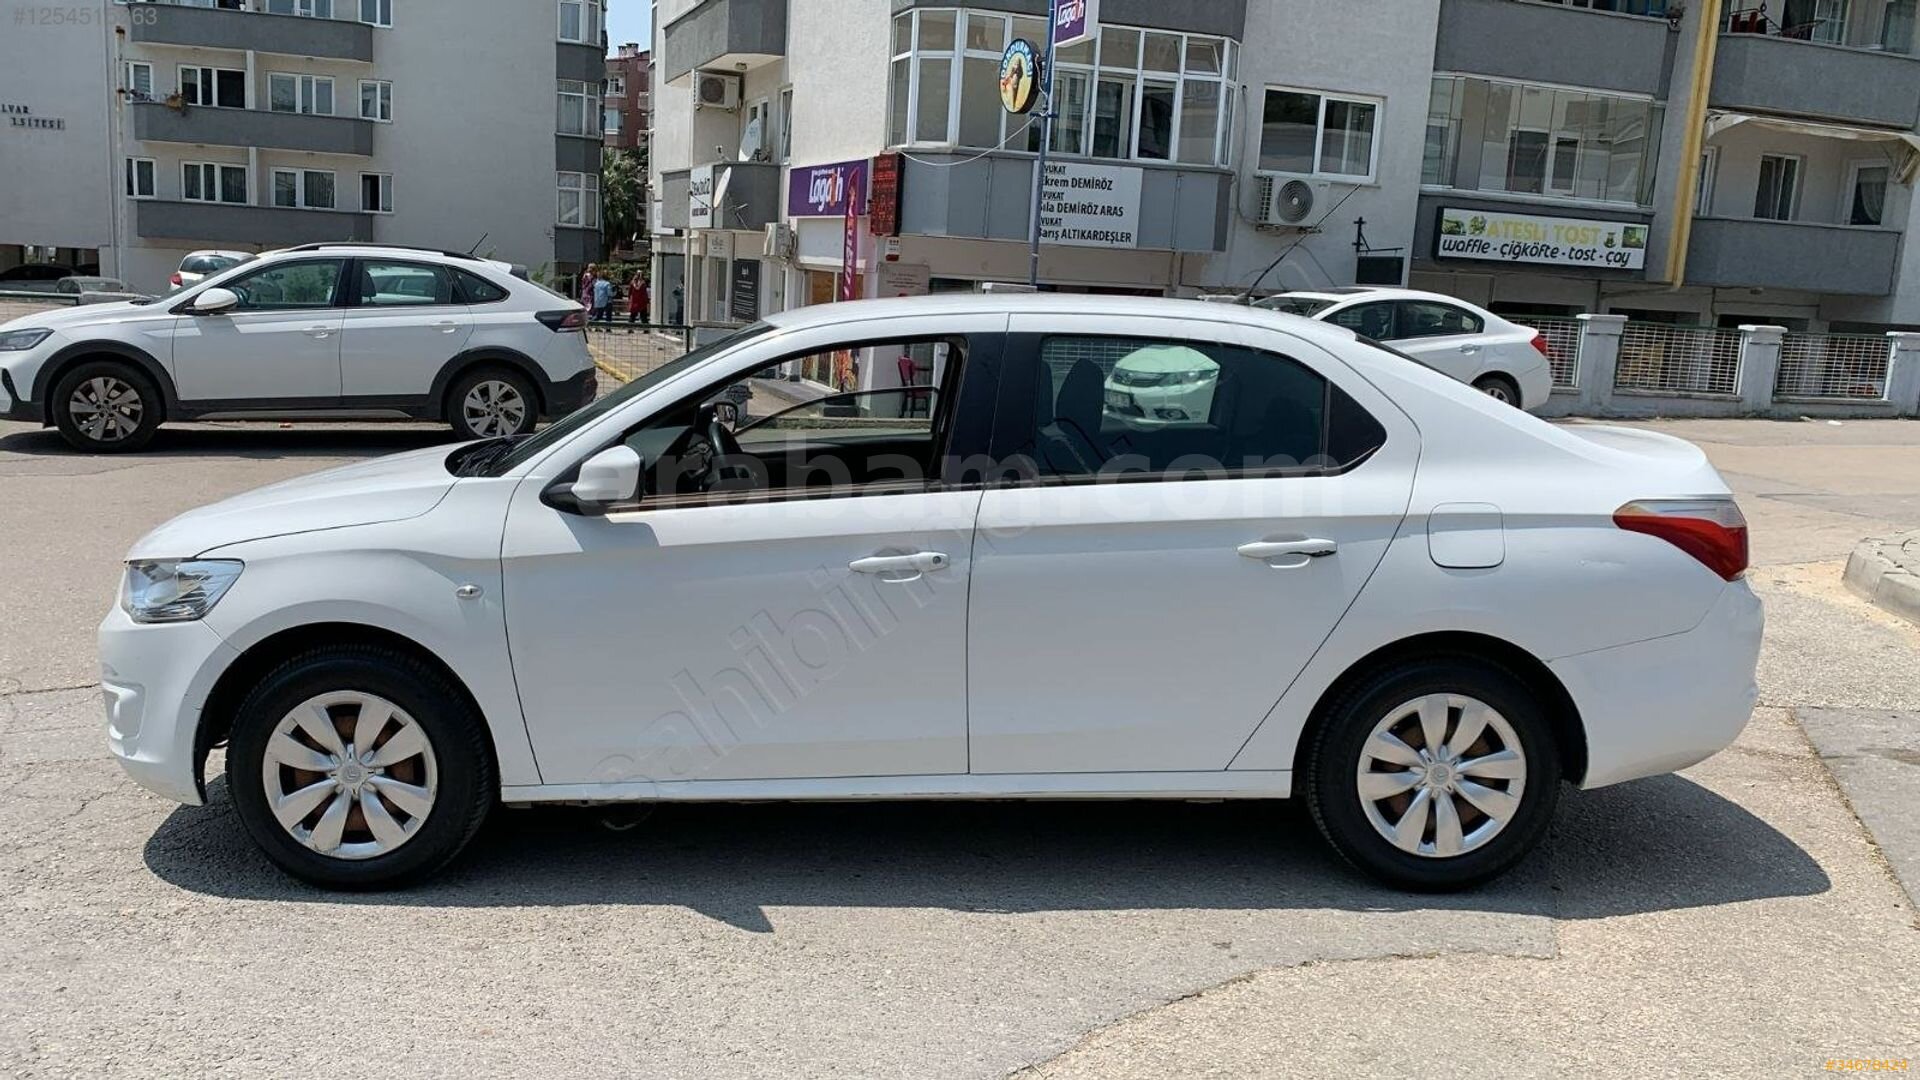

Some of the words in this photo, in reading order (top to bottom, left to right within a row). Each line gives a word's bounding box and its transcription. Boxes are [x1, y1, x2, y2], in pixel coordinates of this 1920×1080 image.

[1043, 165, 1066, 174] VUKAT
[1071, 176, 1114, 190] DEMİRÖZ
[1042, 192, 1064, 200] VUKAT
[1057, 202, 1098, 215] DEMİRÖZ
[1100, 205, 1124, 217] ARAS
[1040, 217, 1062, 226] VUKAT
[1061, 228, 1132, 244] ALTIKARDEŞLER
[1553, 224, 1601, 245] TOST
[1442, 238, 1491, 254] waffle
[1500, 240, 1559, 260] çiğköfte
[1568, 246, 1596, 261] tost
